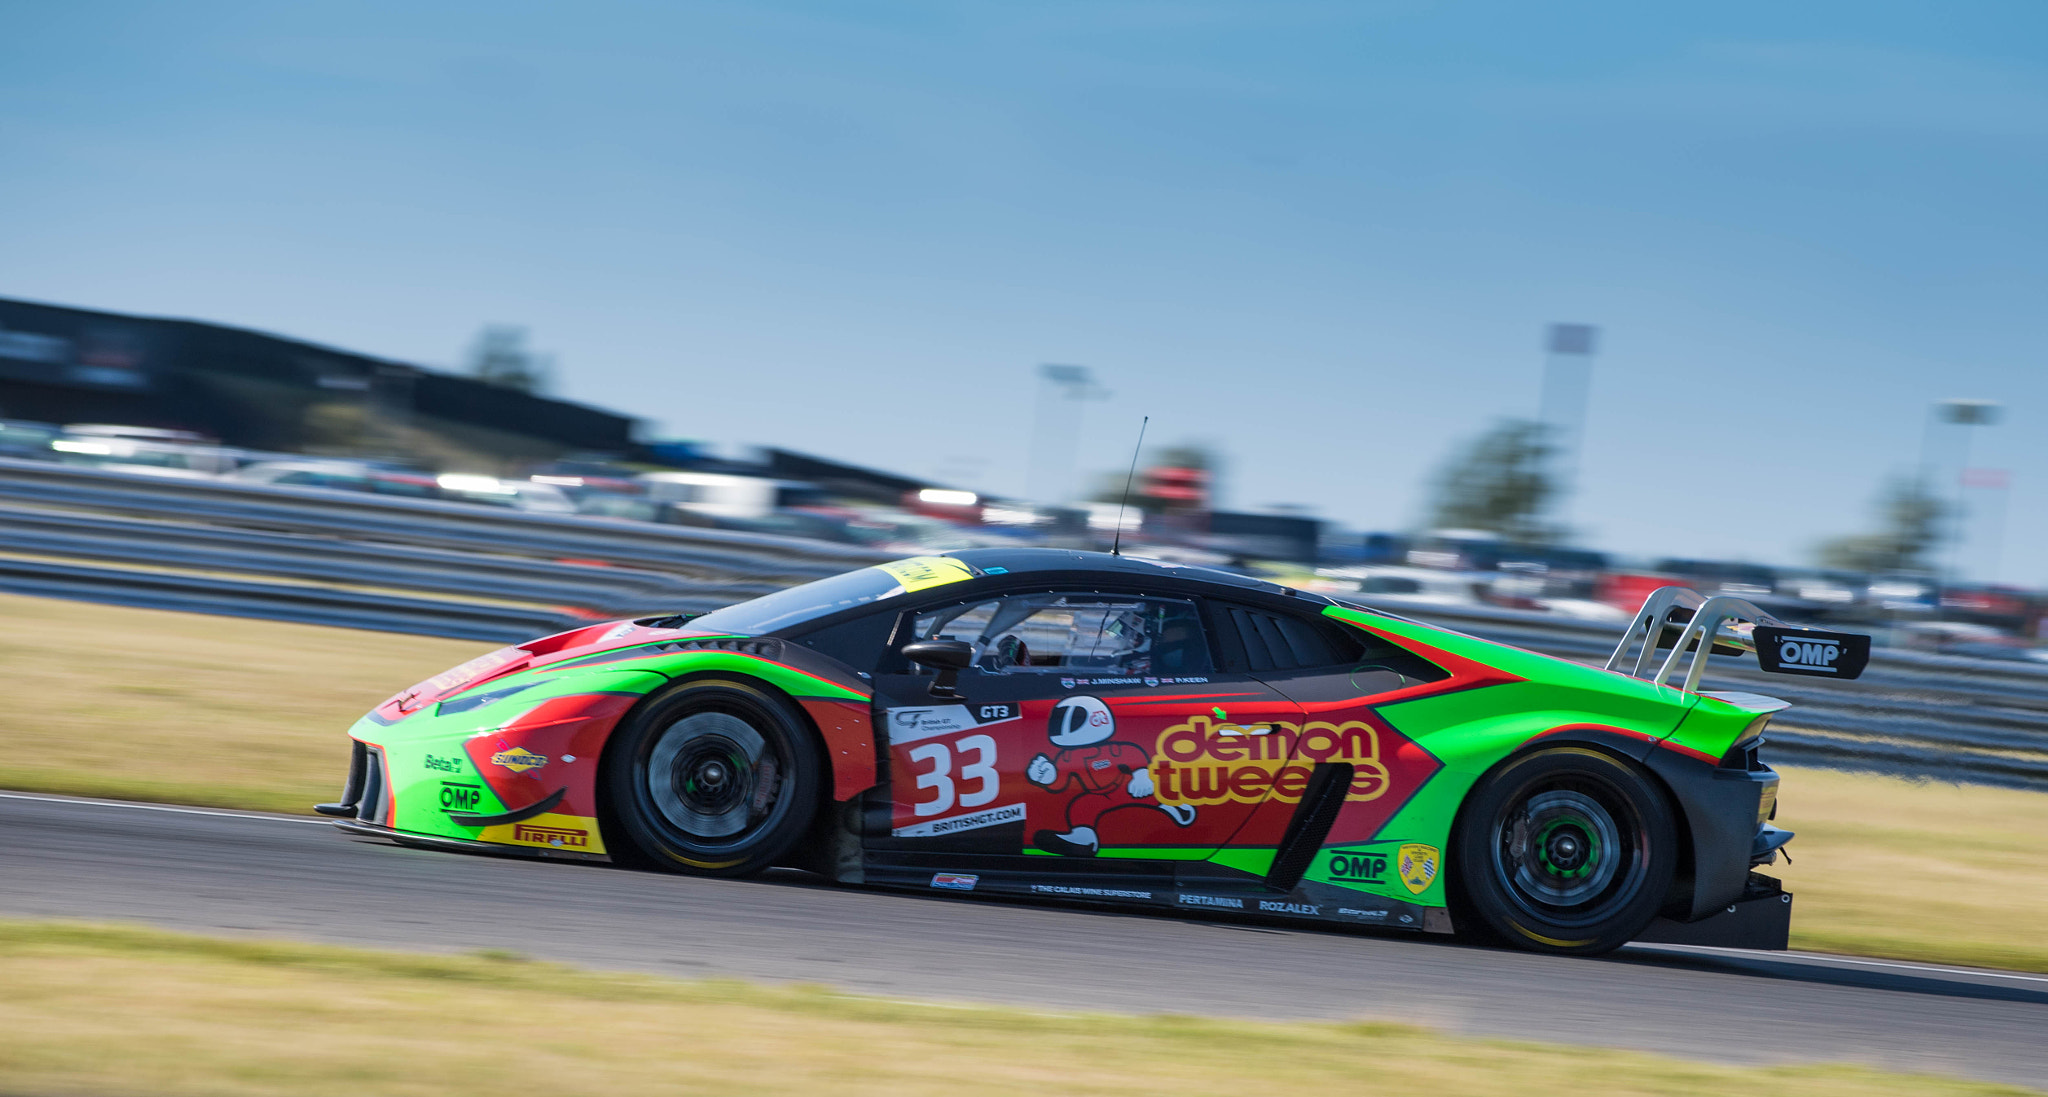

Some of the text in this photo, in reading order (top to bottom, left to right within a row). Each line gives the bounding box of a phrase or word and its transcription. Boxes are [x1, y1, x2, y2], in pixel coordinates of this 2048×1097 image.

[1780, 641, 1840, 667] OMP
[980, 705, 1010, 719] GT3
[1160, 718, 1375, 763] demon
[495, 754, 546, 767] SUNOCO
[909, 734, 1000, 817] 33
[1153, 760, 1384, 801] twees
[439, 787, 481, 811] OMP
[932, 807, 1022, 834] BRITISHGT.COM
[513, 823, 589, 847] PIRELLI
[1329, 855, 1387, 879] OMP
[1037, 884, 1053, 892] THE
[1081, 887, 1103, 896] WINE
[1103, 889, 1152, 899] SUPERSTORE
[1178, 894, 1244, 909] PERTAMINA
[1259, 900, 1320, 915] ROZALEX
